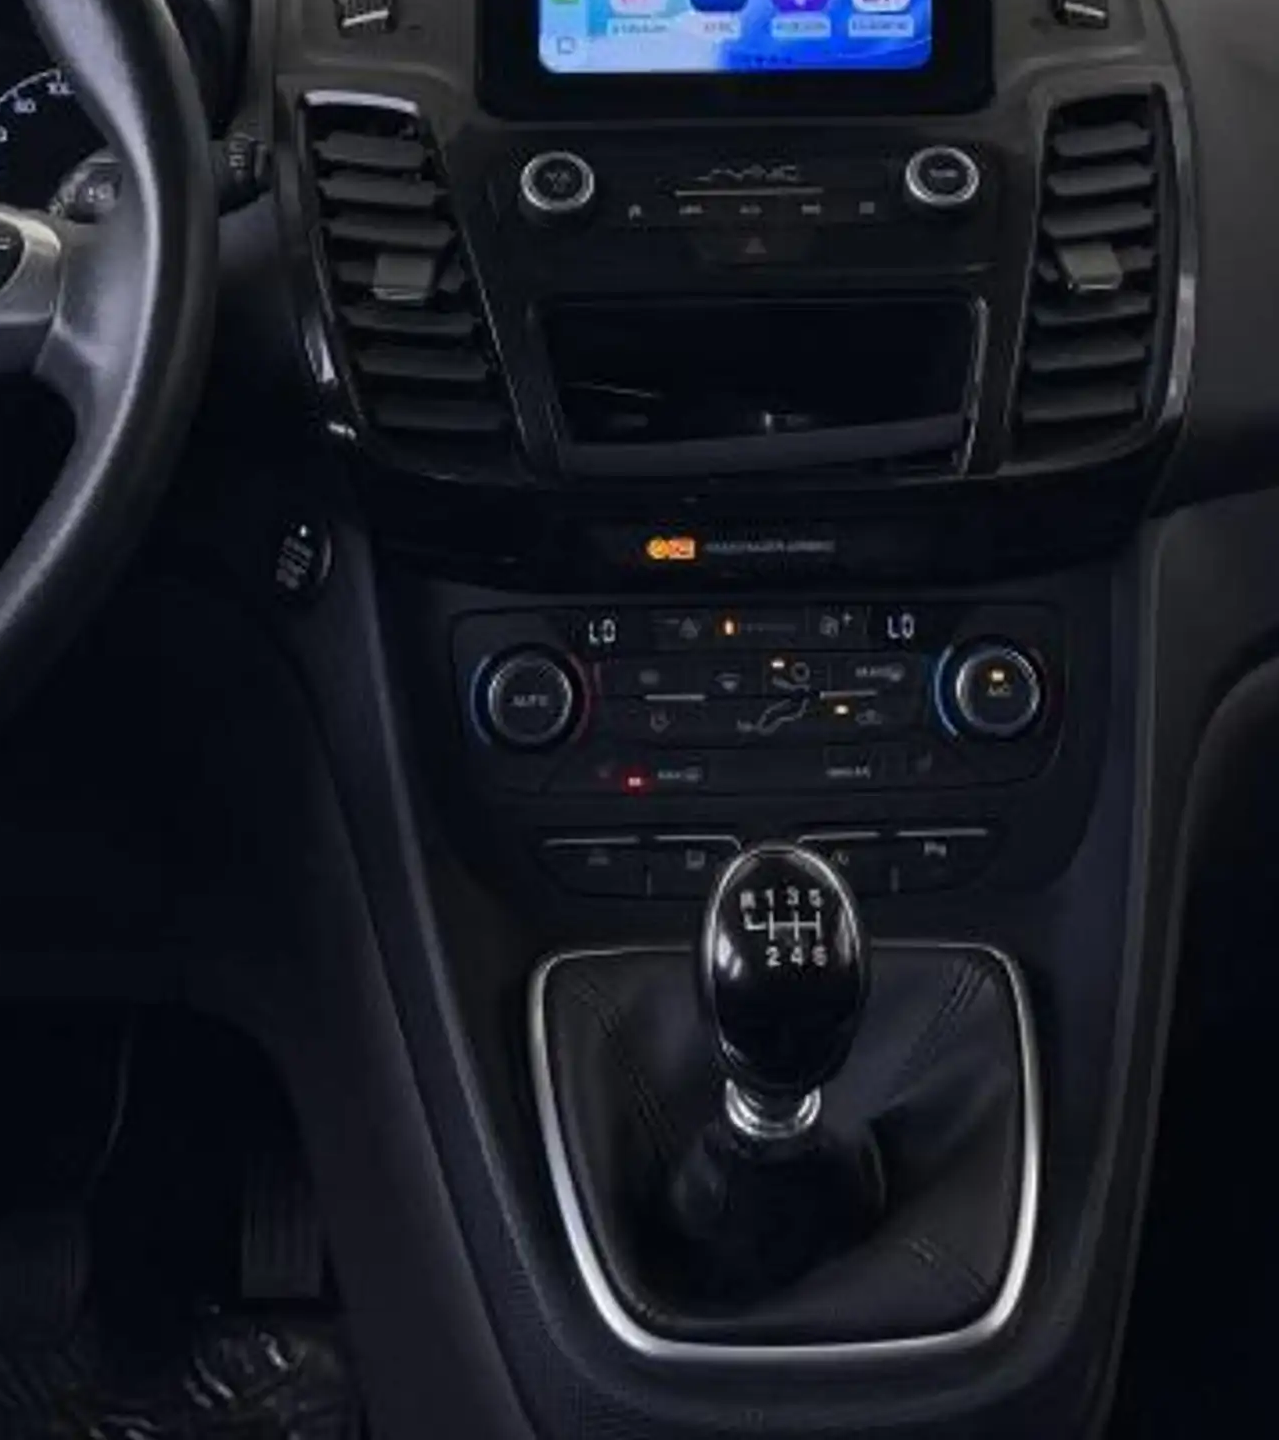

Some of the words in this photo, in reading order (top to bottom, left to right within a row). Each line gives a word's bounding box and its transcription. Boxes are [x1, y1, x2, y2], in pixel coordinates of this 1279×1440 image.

[765, 888, 775, 907] 1
[785, 885, 800, 906] 3
[808, 888, 824, 907] 5
[765, 945, 782, 967] 2
[790, 945, 804, 966] 4
[811, 944, 828, 967] 6
